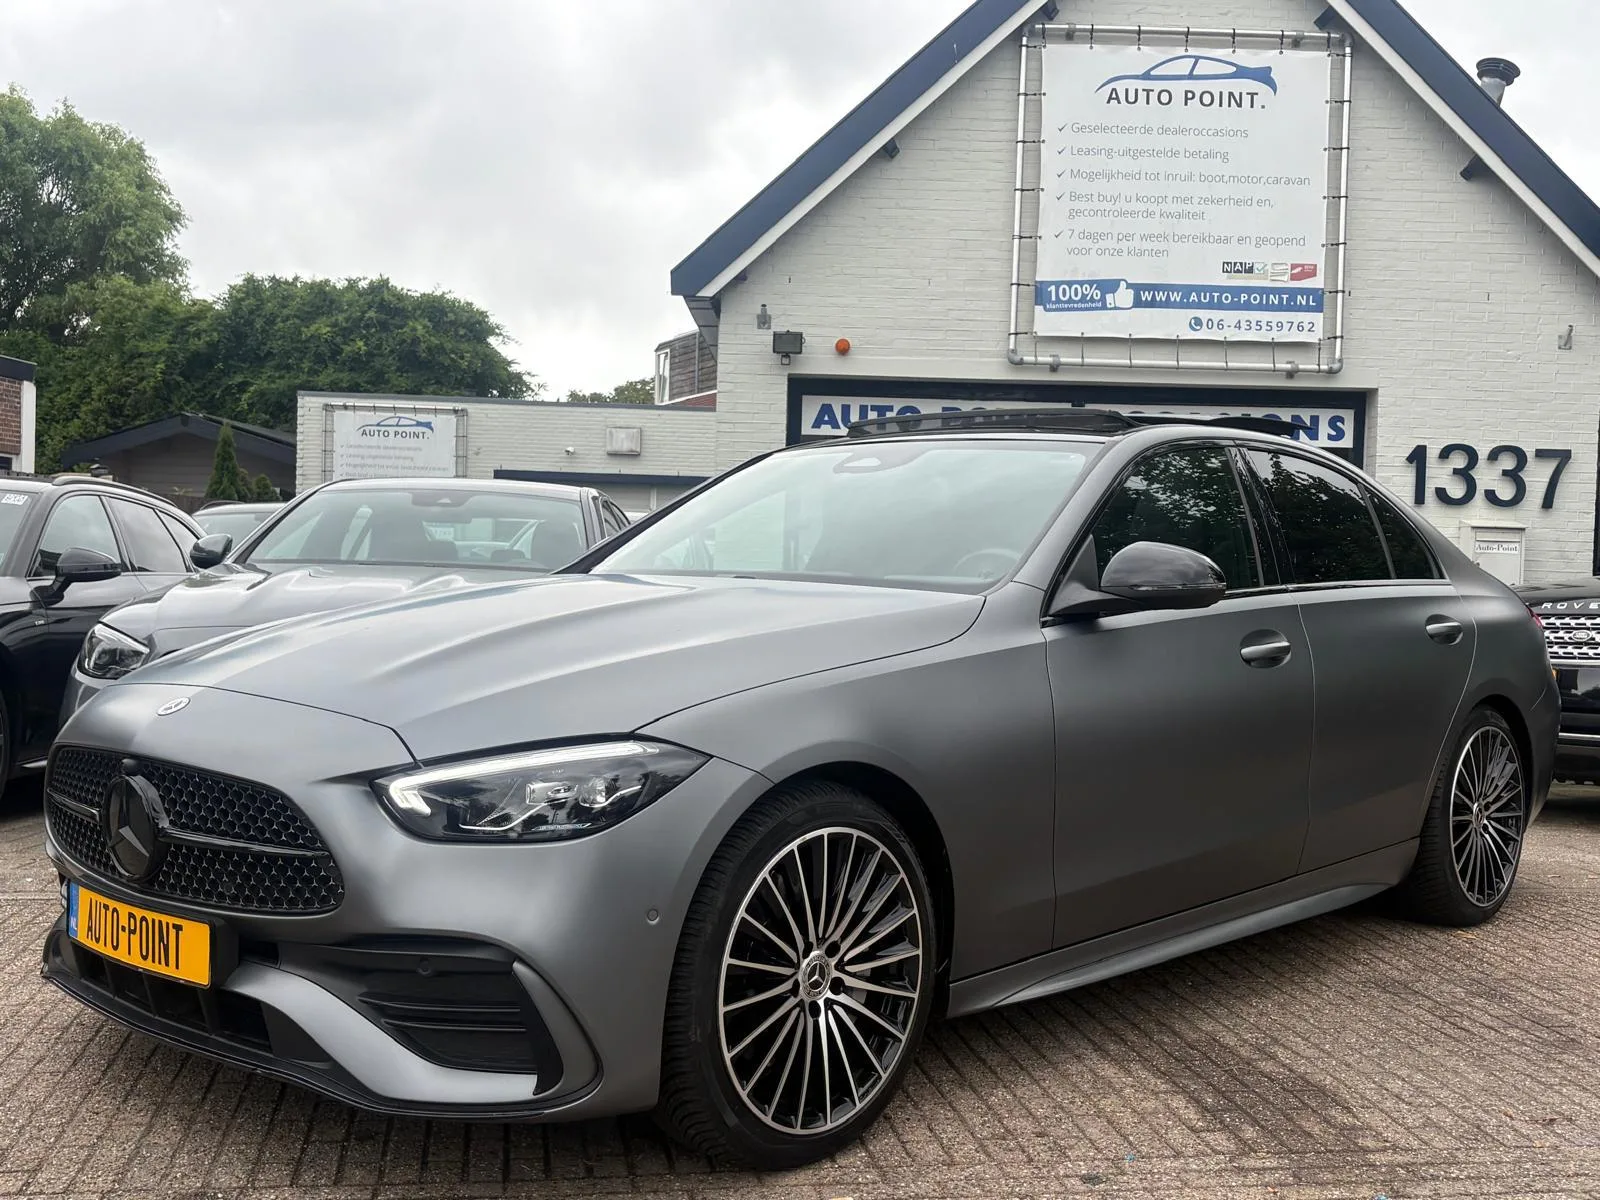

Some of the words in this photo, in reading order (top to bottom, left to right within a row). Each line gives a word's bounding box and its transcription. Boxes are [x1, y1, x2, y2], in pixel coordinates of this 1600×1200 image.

[1106, 87, 1173, 106] AUTO
[1184, 89, 1265, 109] POINT.
[1071, 123, 1154, 135] Geselecteerde
[1157, 124, 1249, 138] dealeroccasions
[1070, 146, 1180, 160] Leasing-uitgestelde
[1184, 147, 1229, 163] betaling
[1070, 169, 1141, 183] Mogelijkheid
[1145, 171, 1160, 182] tot
[1199, 172, 1310, 186] boot,motor,caravan
[1069, 192, 1094, 203] Best
[1097, 192, 1121, 206] buy!
[1136, 193, 1168, 207] koopt
[1172, 195, 1194, 204] met
[1197, 195, 1253, 207] zekerheid
[1256, 199, 1273, 209] en,
[1068, 208, 1156, 222] gecontroleerde
[1159, 208, 1206, 221] kwaliteit
[1068, 229, 1074, 239] 7
[1078, 229, 1113, 243] dagen
[1116, 233, 1136, 244] per
[1139, 231, 1169, 242] week
[1172, 232, 1234, 246] bereikbaar
[1237, 235, 1251, 245] en
[1254, 235, 1305, 248] geopend
[1067, 247, 1092, 256] voor
[1095, 248, 1124, 256] onze
[1127, 246, 1169, 258] klanten
[1223, 262, 1253, 274] NAP
[1047, 284, 1100, 301] 100%
[1140, 290, 1316, 305] WWW.AUTO-POINT.NL
[1207, 319, 1315, 333] 06-43559762
[361, 429, 389, 438] AUTO
[1406, 444, 1572, 509] 1337
[1476, 544, 1518, 552] Auto-Point
[87, 898, 184, 970] AUTO-POINT
